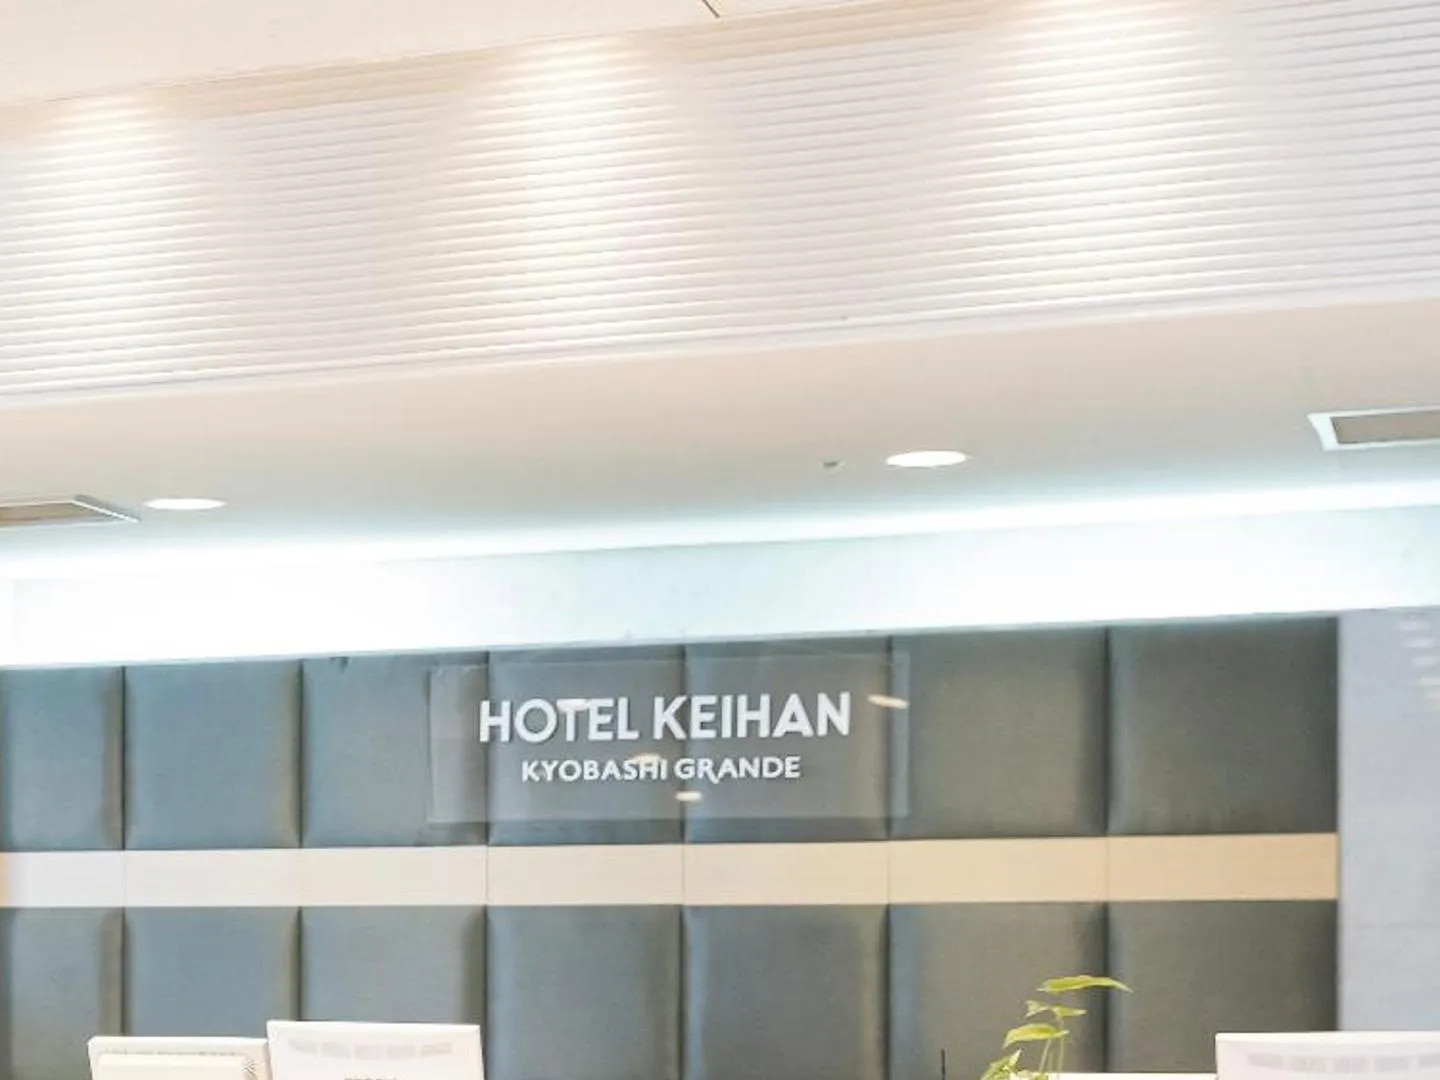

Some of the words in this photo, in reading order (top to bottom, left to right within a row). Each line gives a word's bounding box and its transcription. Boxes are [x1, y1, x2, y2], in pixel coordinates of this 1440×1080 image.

[478, 695, 640, 744] HOTEL
[653, 691, 852, 740] KEIHAN
[521, 757, 667, 783] KYOBASHI
[673, 756, 801, 784] GRANDE
